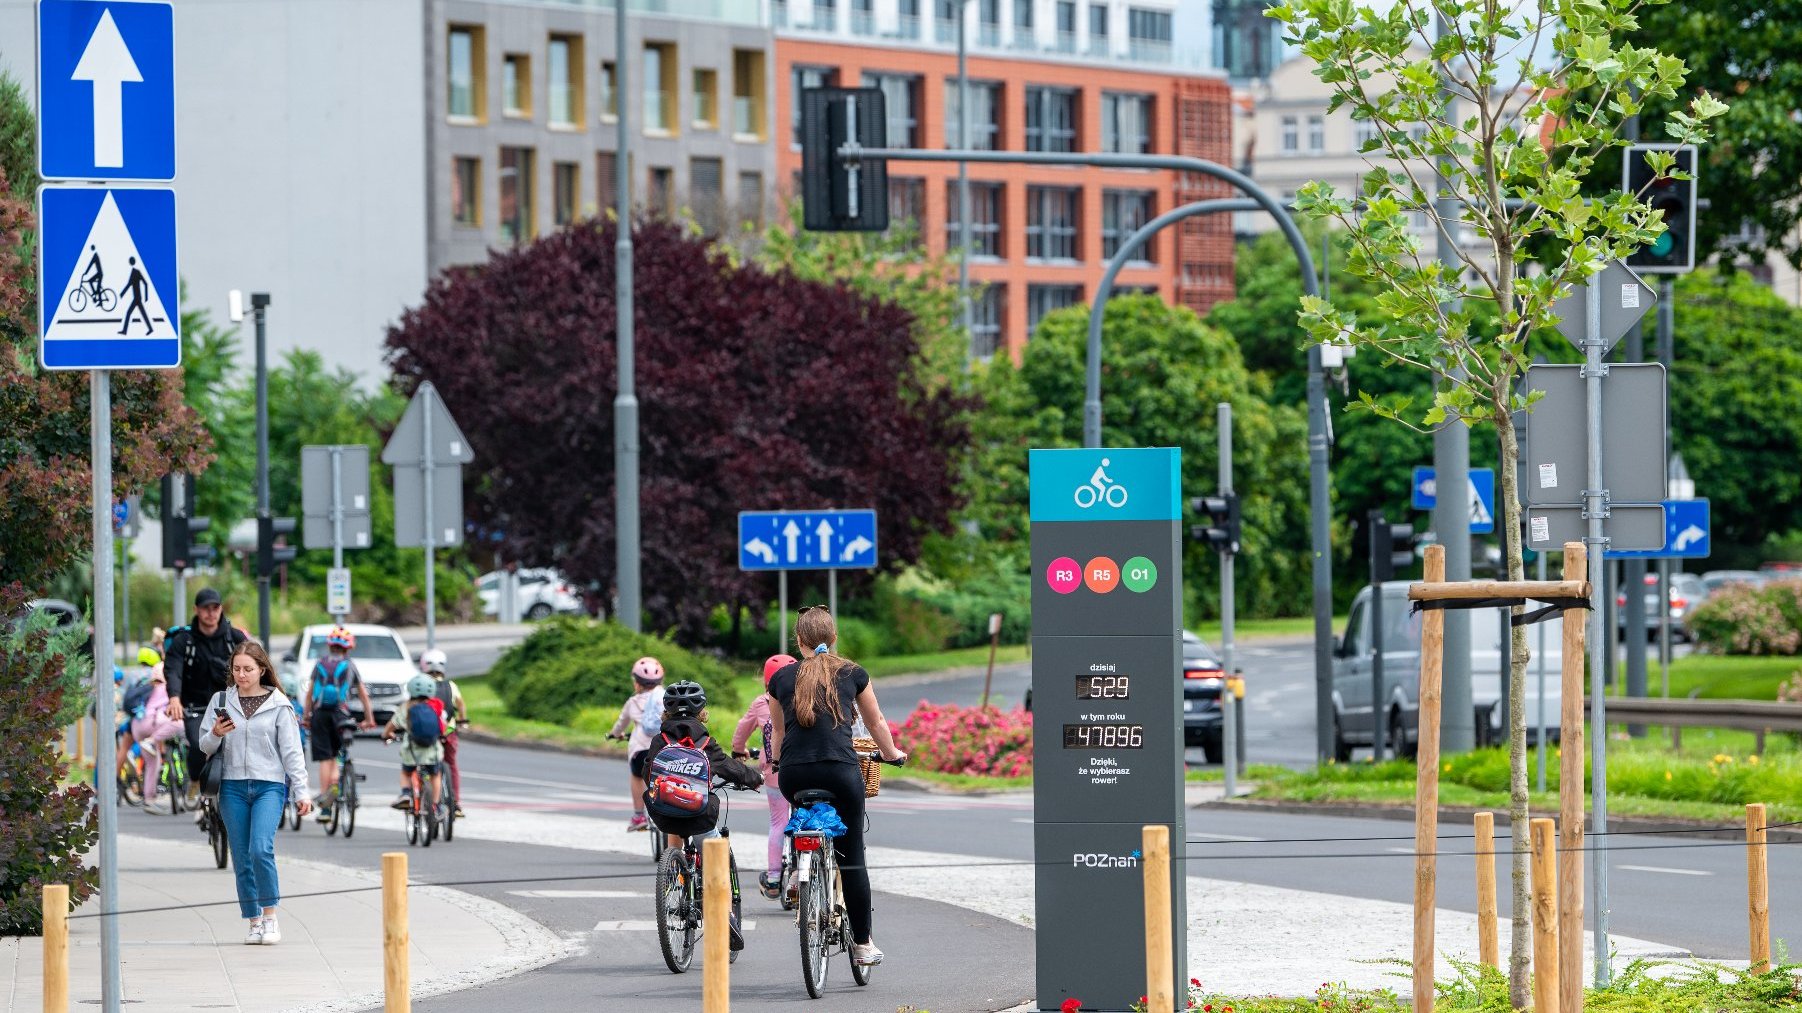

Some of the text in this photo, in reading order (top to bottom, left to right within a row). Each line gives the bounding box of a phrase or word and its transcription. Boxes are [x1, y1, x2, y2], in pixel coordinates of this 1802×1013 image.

[1056, 570, 1073, 581] R3
[1093, 569, 1111, 580] R5
[1090, 663, 1116, 673] dzisiaj
[1090, 676, 1129, 698] 529
[1080, 712, 1126, 722] w tym roku
[1078, 726, 1143, 746] 47896
[1090, 757, 1118, 767] Dzięki,
[1078, 766, 1131, 776] że wybierasz
[1091, 776, 1117, 784] rower!
